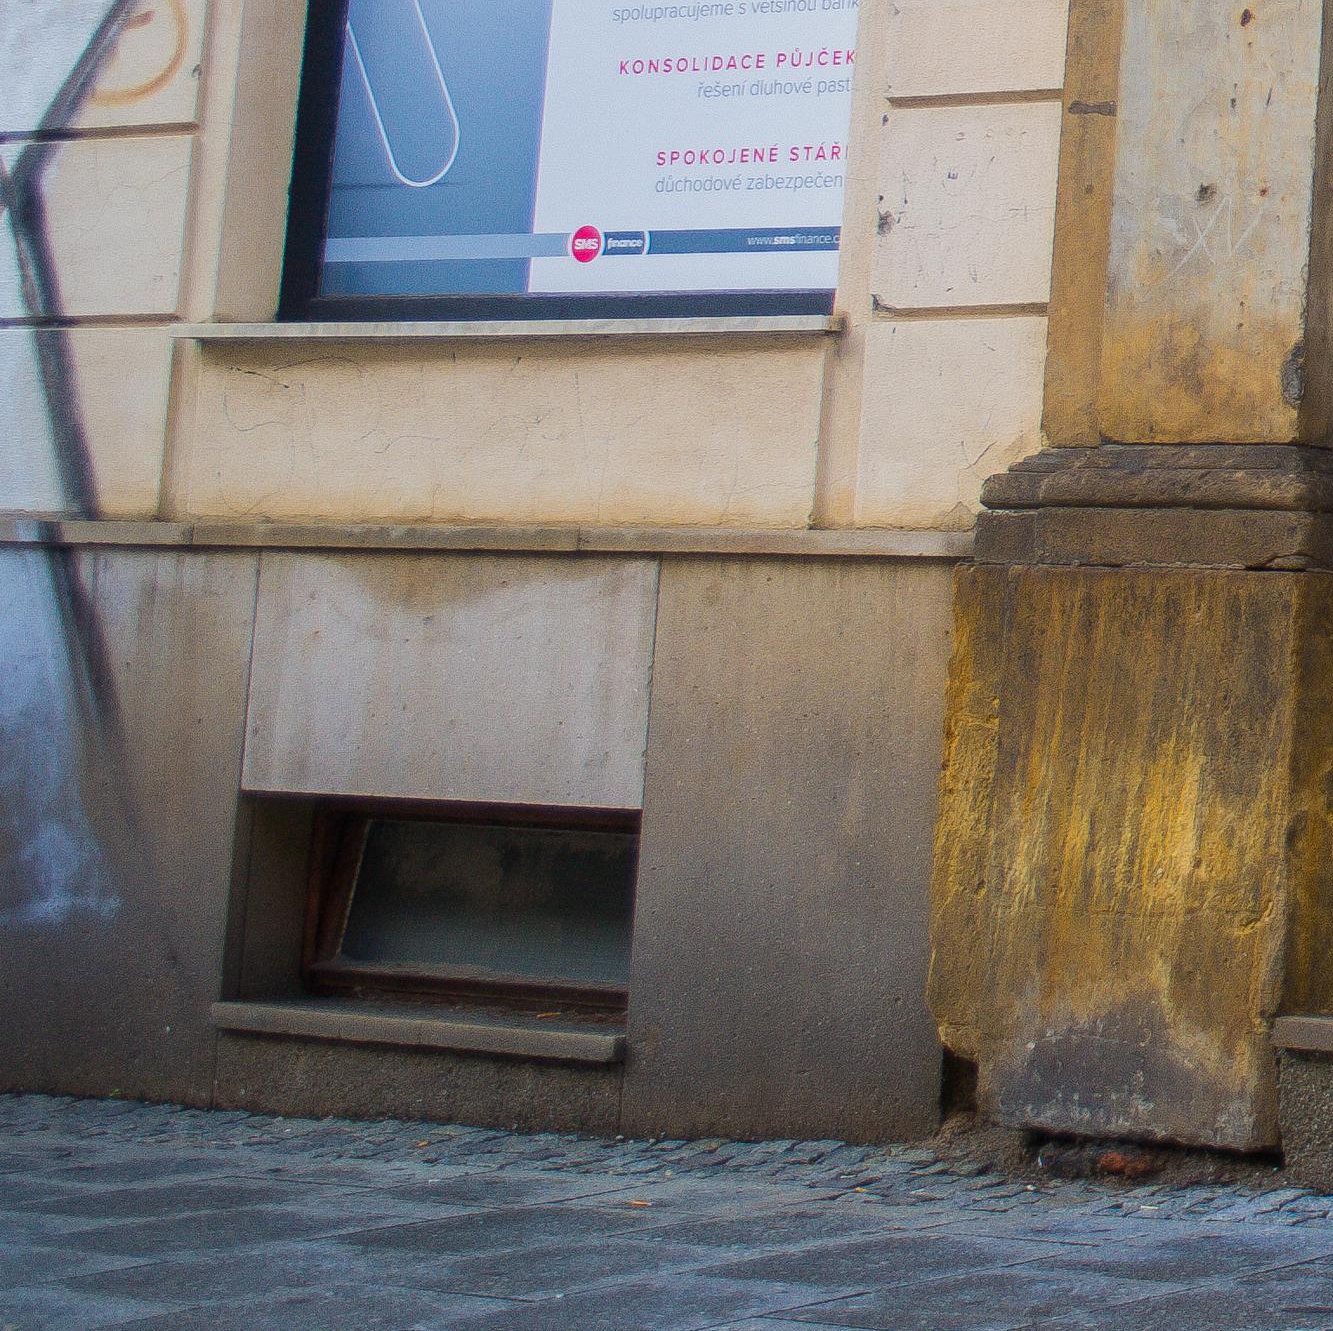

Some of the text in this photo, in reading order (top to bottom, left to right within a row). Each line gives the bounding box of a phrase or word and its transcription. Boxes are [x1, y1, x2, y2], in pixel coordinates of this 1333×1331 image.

[612, 0, 734, 23] spolupracujeme
[739, 1, 747, 15] s
[619, 47, 856, 74] KONSOLIDACE PŮJČEK
[698, 81, 745, 98] řešení
[750, 77, 812, 96] dluhové
[657, 144, 777, 166] SPOKOJENÉ
[656, 174, 742, 193] důchodové
[573, 237, 643, 250] SMS finance
